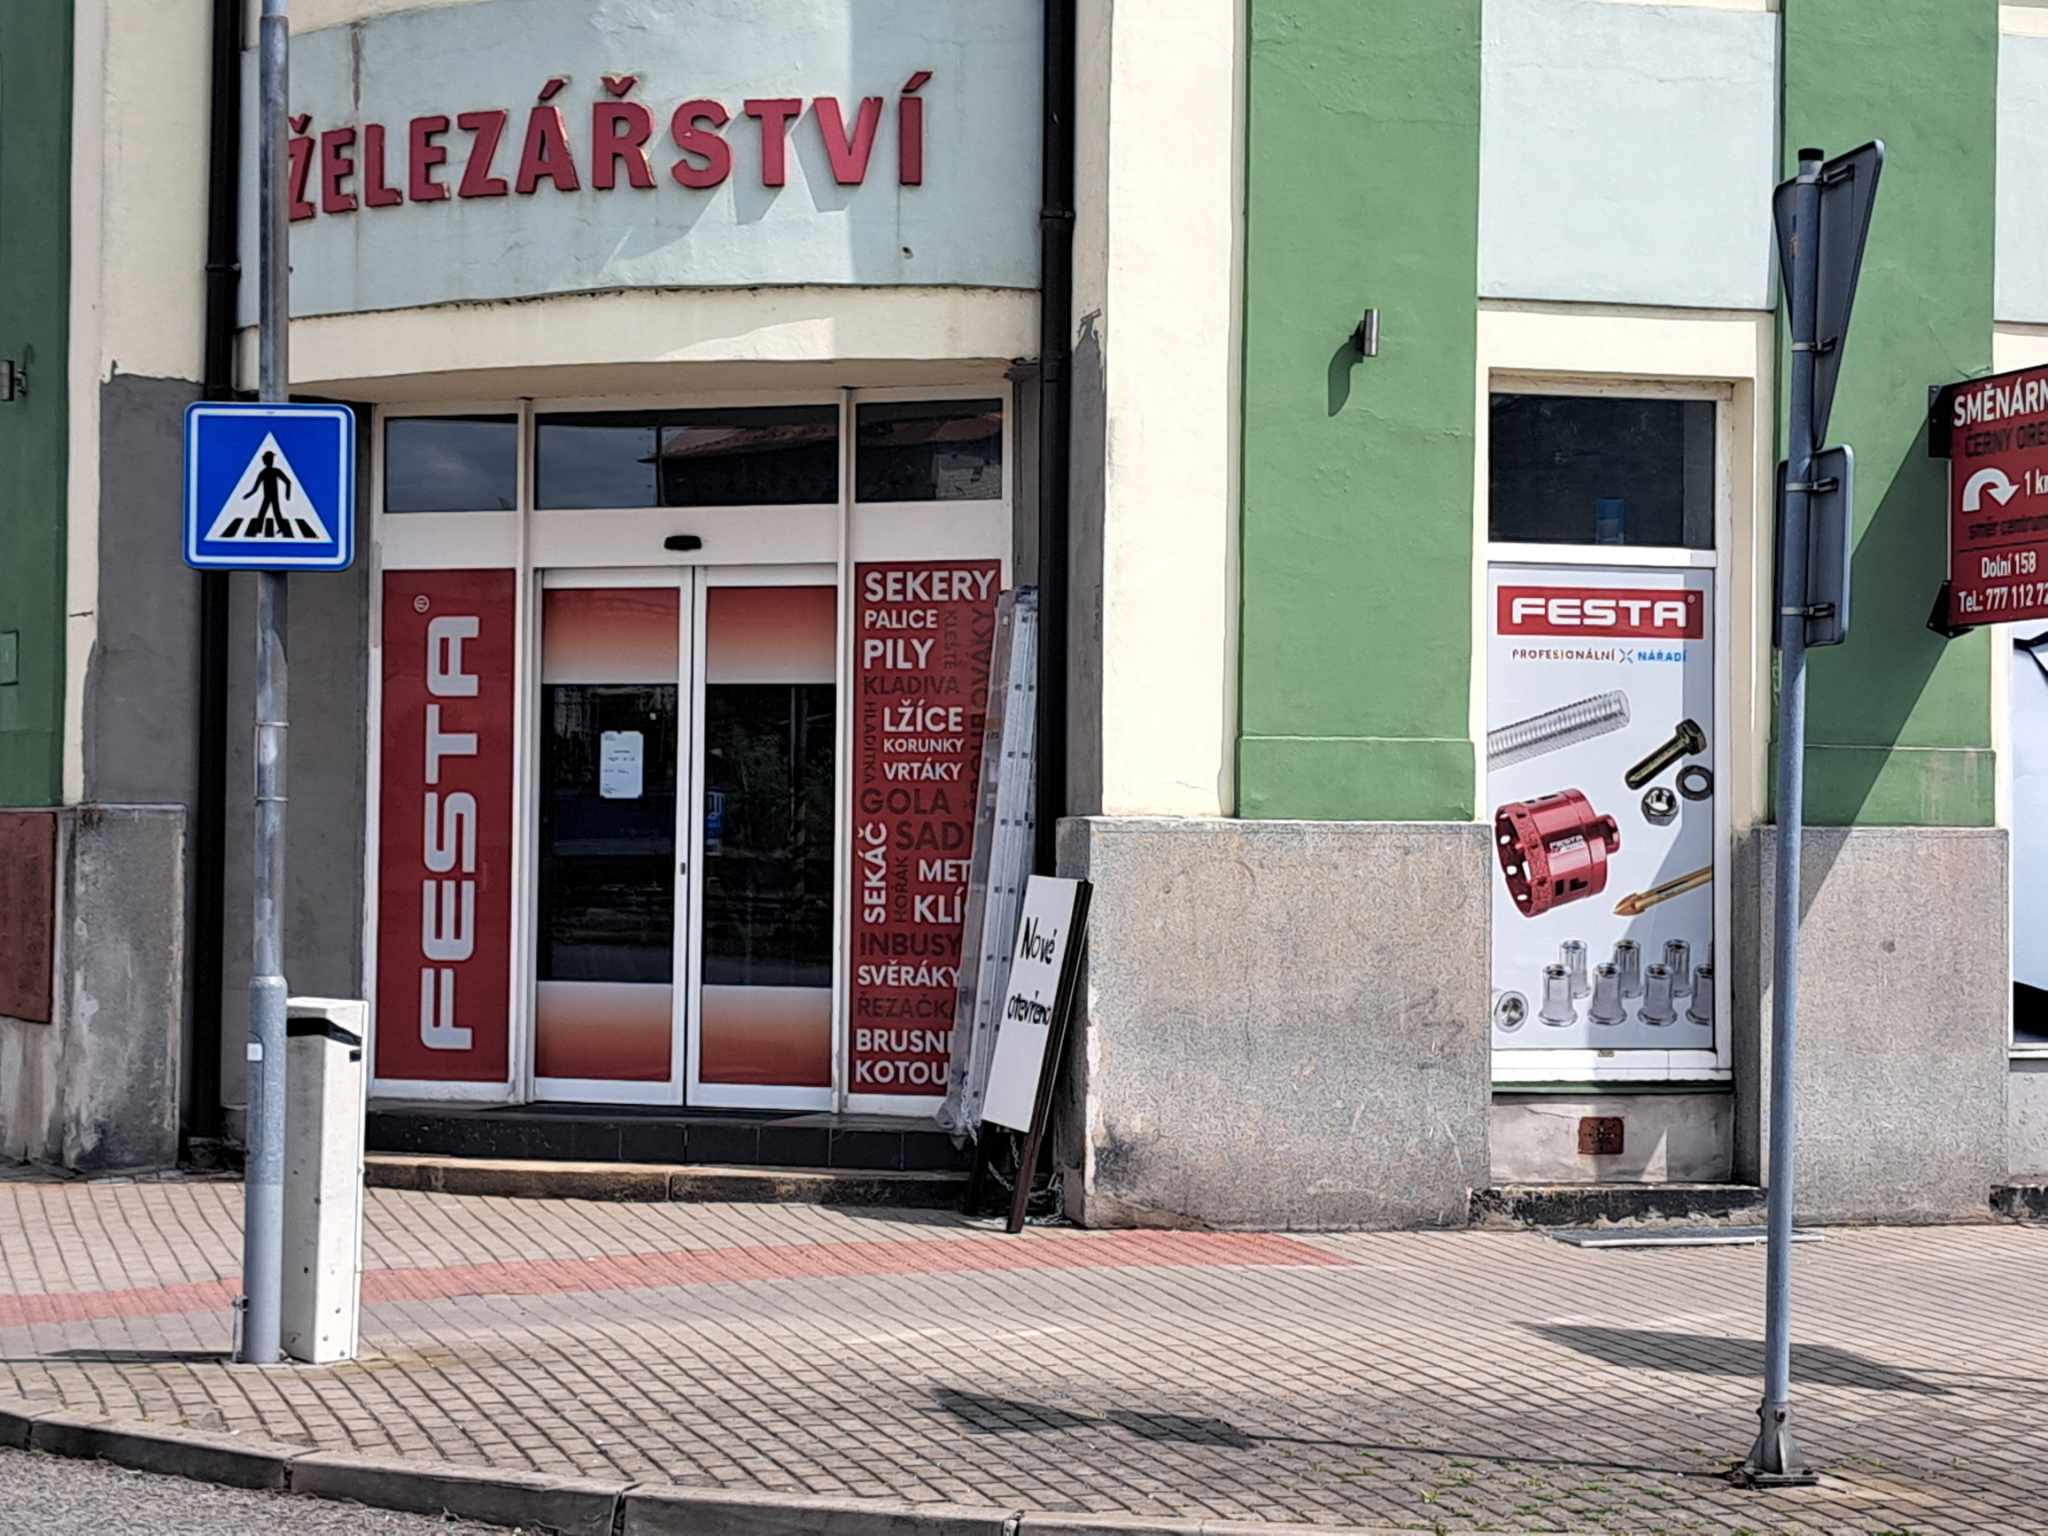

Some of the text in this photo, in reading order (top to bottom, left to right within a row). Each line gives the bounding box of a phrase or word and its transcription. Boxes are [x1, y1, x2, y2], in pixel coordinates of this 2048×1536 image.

[288, 71, 933, 222] ŽELEZÁŘSTVÍ
[2024, 470, 2031, 496] 1
[1981, 551, 2036, 579] Dolní 158
[864, 569, 997, 603] SEKERY
[1986, 586, 2008, 611] 777
[2012, 583, 2034, 609] 112
[864, 608, 938, 630] PALICE
[1511, 597, 1687, 628] FESTA
[863, 638, 936, 670] PILY
[1512, 647, 1615, 662] PROFESIONÁLNÍ
[863, 676, 960, 695] KLADIVA
[883, 698, 964, 733] LŽÍCE
[883, 738, 965, 753] KORUNKY
[883, 757, 964, 782] VRTÁKY
[860, 788, 951, 815] GOLA
[420, 615, 480, 1050] FESTA
[896, 820, 972, 851] SAD
[857, 822, 887, 924] SEKÁČ
[860, 932, 961, 957] INBUSY
[1020, 916, 1057, 965] Nové
[857, 959, 959, 988] SVĚRÁKY
